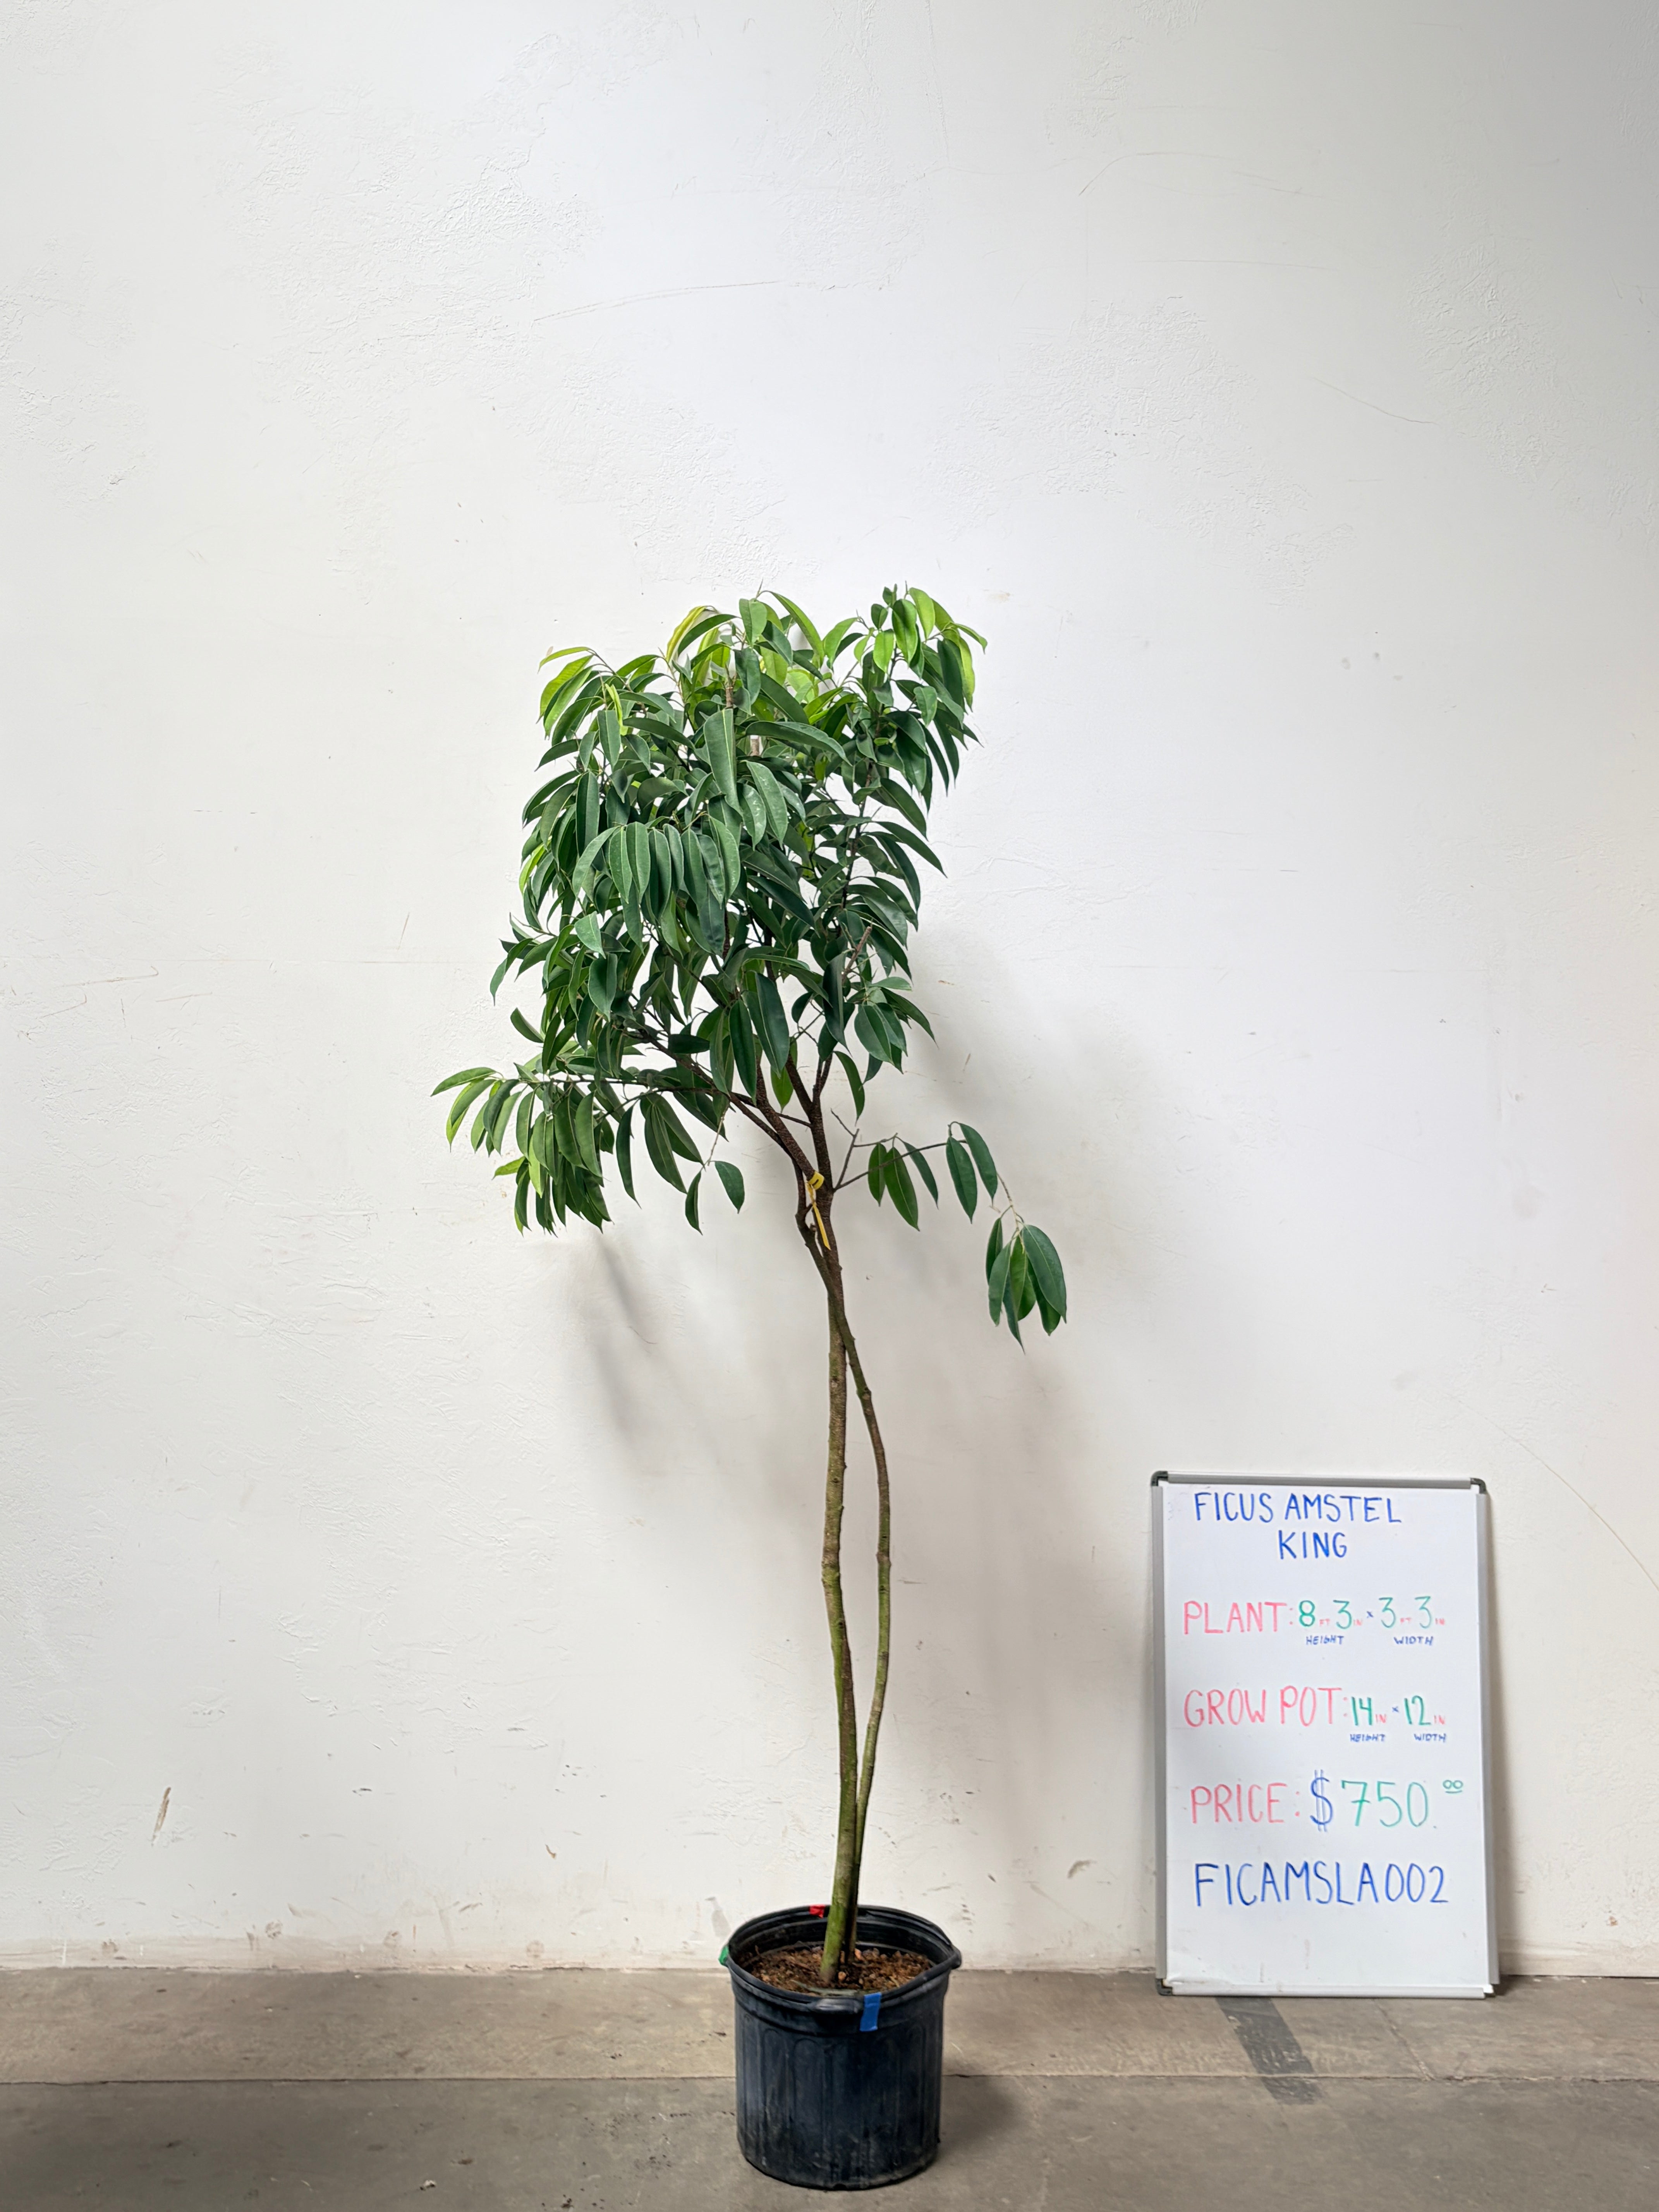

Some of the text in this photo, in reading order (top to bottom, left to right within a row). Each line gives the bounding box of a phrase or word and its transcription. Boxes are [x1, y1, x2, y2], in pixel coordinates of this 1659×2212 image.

[1194, 1492, 1402, 1524] FICUS AMSTEL
[1278, 1530, 1348, 1560] KING
[1306, 1635, 1345, 1645] HEIGHT
[1394, 1636, 1434, 1646] WIDTH
[1183, 1688, 1267, 1728] GROW
[1350, 1733, 1386, 1742] HEIGHT
[1413, 1733, 1446, 1743] WIDTH
[1190, 1782, 1300, 1824] PRICE:
[1195, 1860, 1449, 1908] FICAMSLA002
